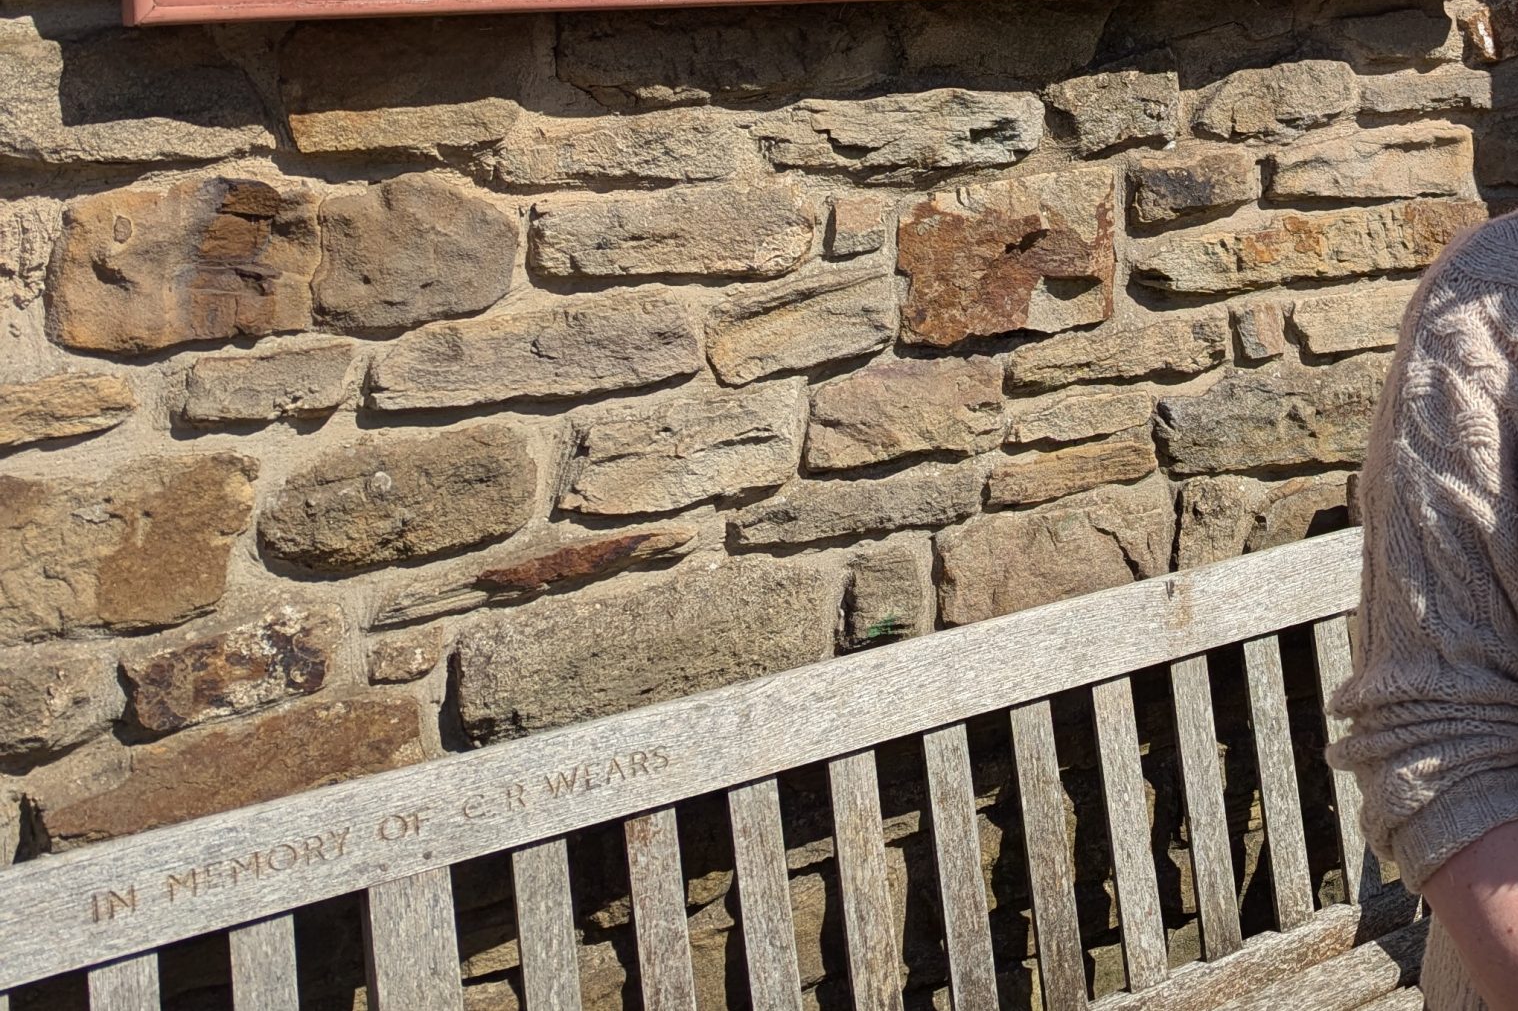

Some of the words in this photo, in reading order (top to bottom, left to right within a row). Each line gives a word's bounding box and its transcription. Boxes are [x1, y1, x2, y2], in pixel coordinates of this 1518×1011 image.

[91, 884, 137, 924] IN
[165, 826, 351, 903] MEMORY
[378, 806, 430, 842] OF
[543, 745, 671, 800] WEARS
